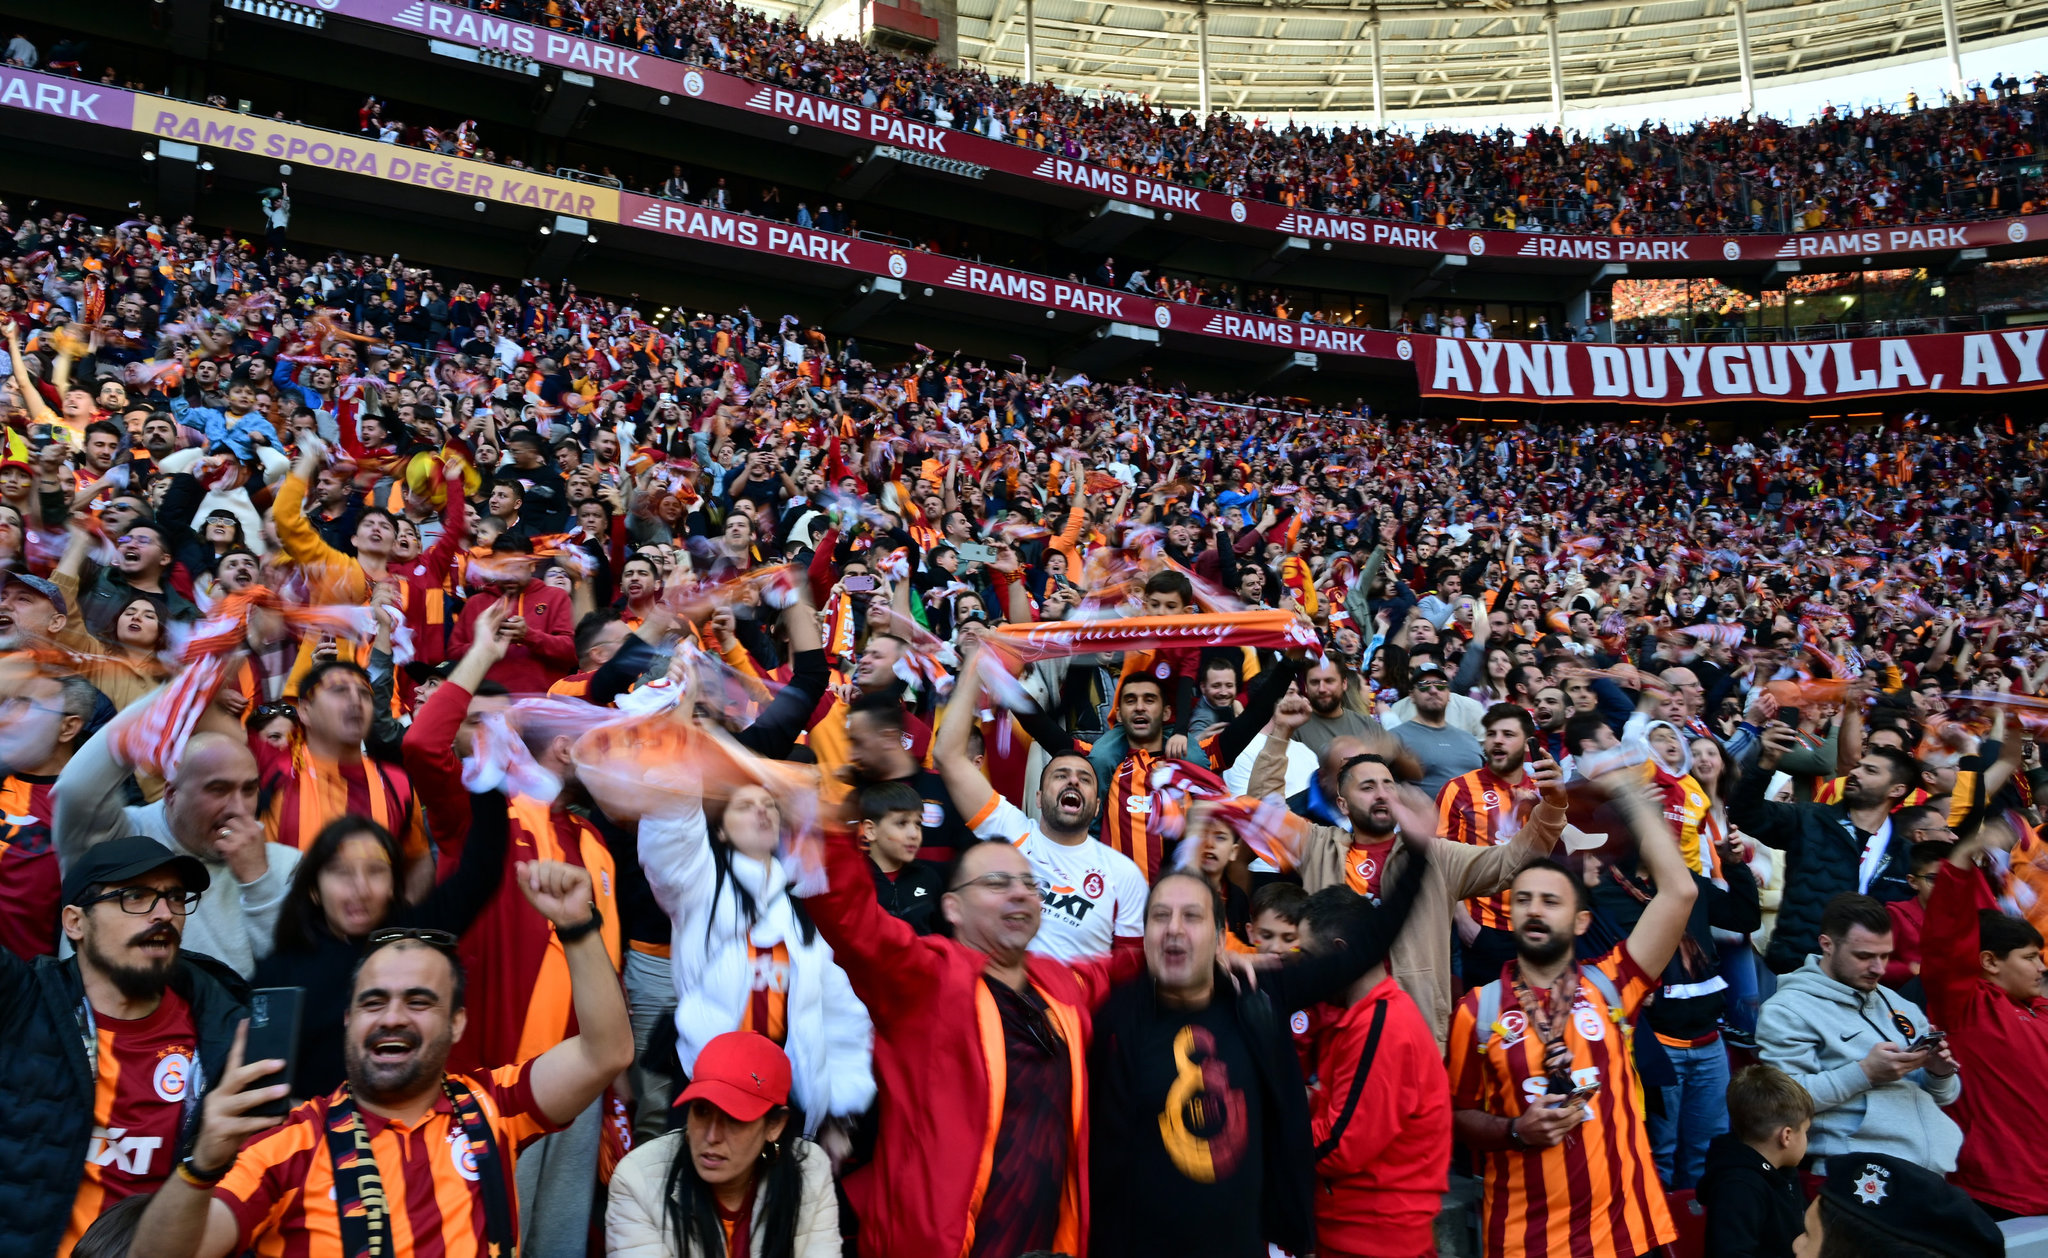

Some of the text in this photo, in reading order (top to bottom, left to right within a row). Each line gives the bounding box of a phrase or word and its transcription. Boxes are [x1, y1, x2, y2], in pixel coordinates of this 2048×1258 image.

[428, 4, 640, 79] RAMS PARK
[0, 76, 101, 121] ARK
[775, 90, 947, 153] RAMS PARK
[153, 111, 596, 218] RAMS SPORA DEĞER KATAR
[1056, 159, 1202, 211] RAMS PARK
[664, 206, 851, 265] RAMS PARK
[1296, 214, 1439, 250] RAMS PARK
[1539, 237, 1690, 260] RAMS PARK
[1800, 226, 1969, 257] RAMS PARK
[969, 267, 1124, 317] RAMS PARK
[1224, 315, 1367, 353] RAMS PARK
[1432, 329, 2048, 397] AYNI DUYGUYLA, AY
